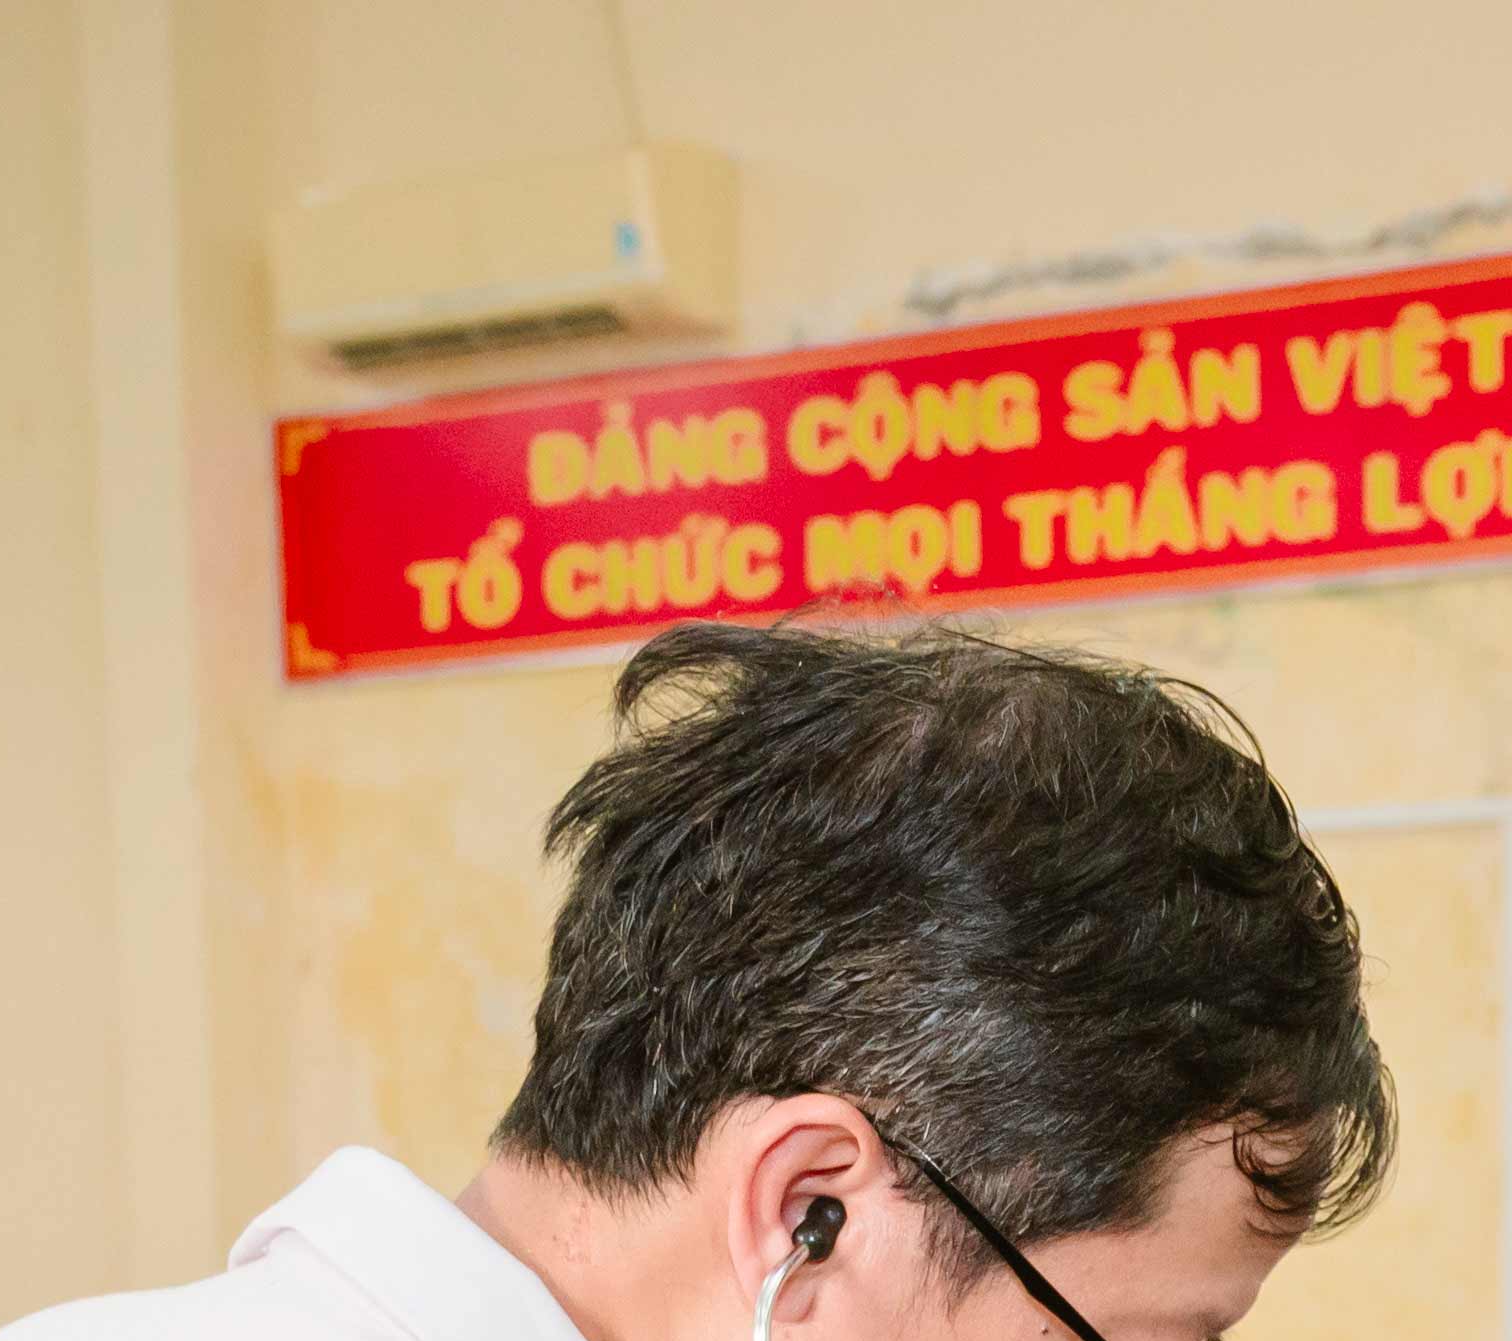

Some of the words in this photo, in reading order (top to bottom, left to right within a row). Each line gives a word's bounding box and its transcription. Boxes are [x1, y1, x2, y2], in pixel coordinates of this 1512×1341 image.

[787, 374, 1039, 479] CỘNG
[1065, 331, 1260, 438] SẢN
[406, 517, 522, 632] TỔ
[543, 514, 782, 619] CHỨC
[804, 500, 982, 595] MỌI
